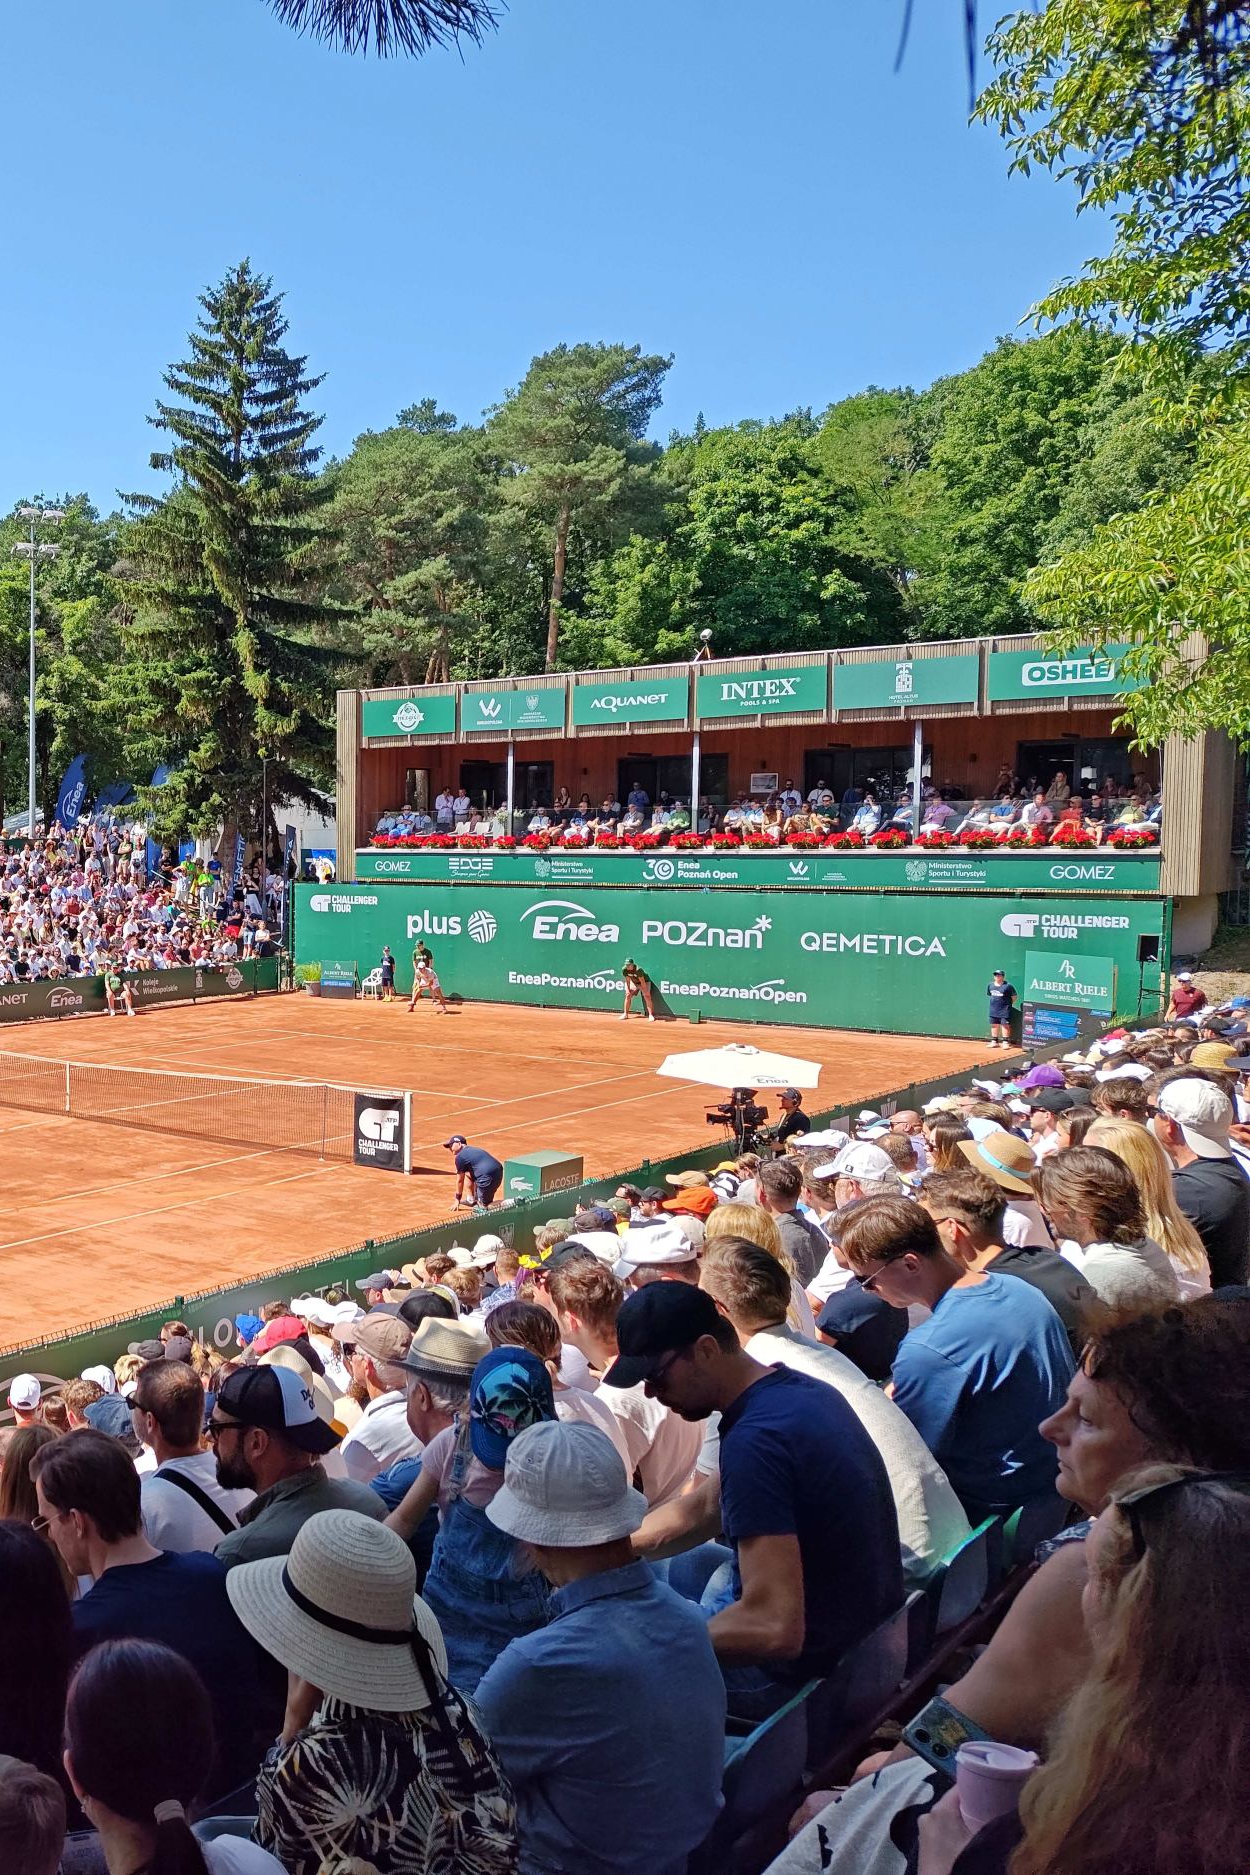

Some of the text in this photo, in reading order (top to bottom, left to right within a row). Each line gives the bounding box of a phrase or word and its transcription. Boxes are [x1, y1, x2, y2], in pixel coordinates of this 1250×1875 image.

[1027, 663, 1108, 682] OSHEE
[721, 677, 797, 701] INTEX
[740, 700, 760, 708] POOLS
[66, 782, 85, 817] Enea
[374, 860, 411, 872] GOMEZ
[449, 858, 493, 870] EDGE
[677, 861, 699, 869] Enea
[571, 867, 593, 875] Turystyki
[677, 869, 738, 880] Poznań Open
[928, 869, 950, 877] Sportu
[955, 869, 986, 879] Turystyki
[1050, 865, 1115, 880] GOMEZ
[331, 895, 378, 906] CHALLENGER
[331, 904, 352, 913] TOUR
[407, 910, 461, 938] plus
[1041, 914, 1130, 929] CHALLENGER
[533, 916, 620, 943] Enea
[1041, 926, 1078, 939] TOUR
[800, 931, 947, 957] QEMETICA
[142, 978, 159, 988] Koleje
[143, 984, 178, 995] Wielkopolskie
[1030, 978, 1108, 997] ALBERT RIELE
[50, 993, 83, 1008] Enea
[359, 1139, 399, 1152] CHALLENGER
[359, 1146, 376, 1157] TOUR
[544, 1173, 580, 1191] LACOSTE
